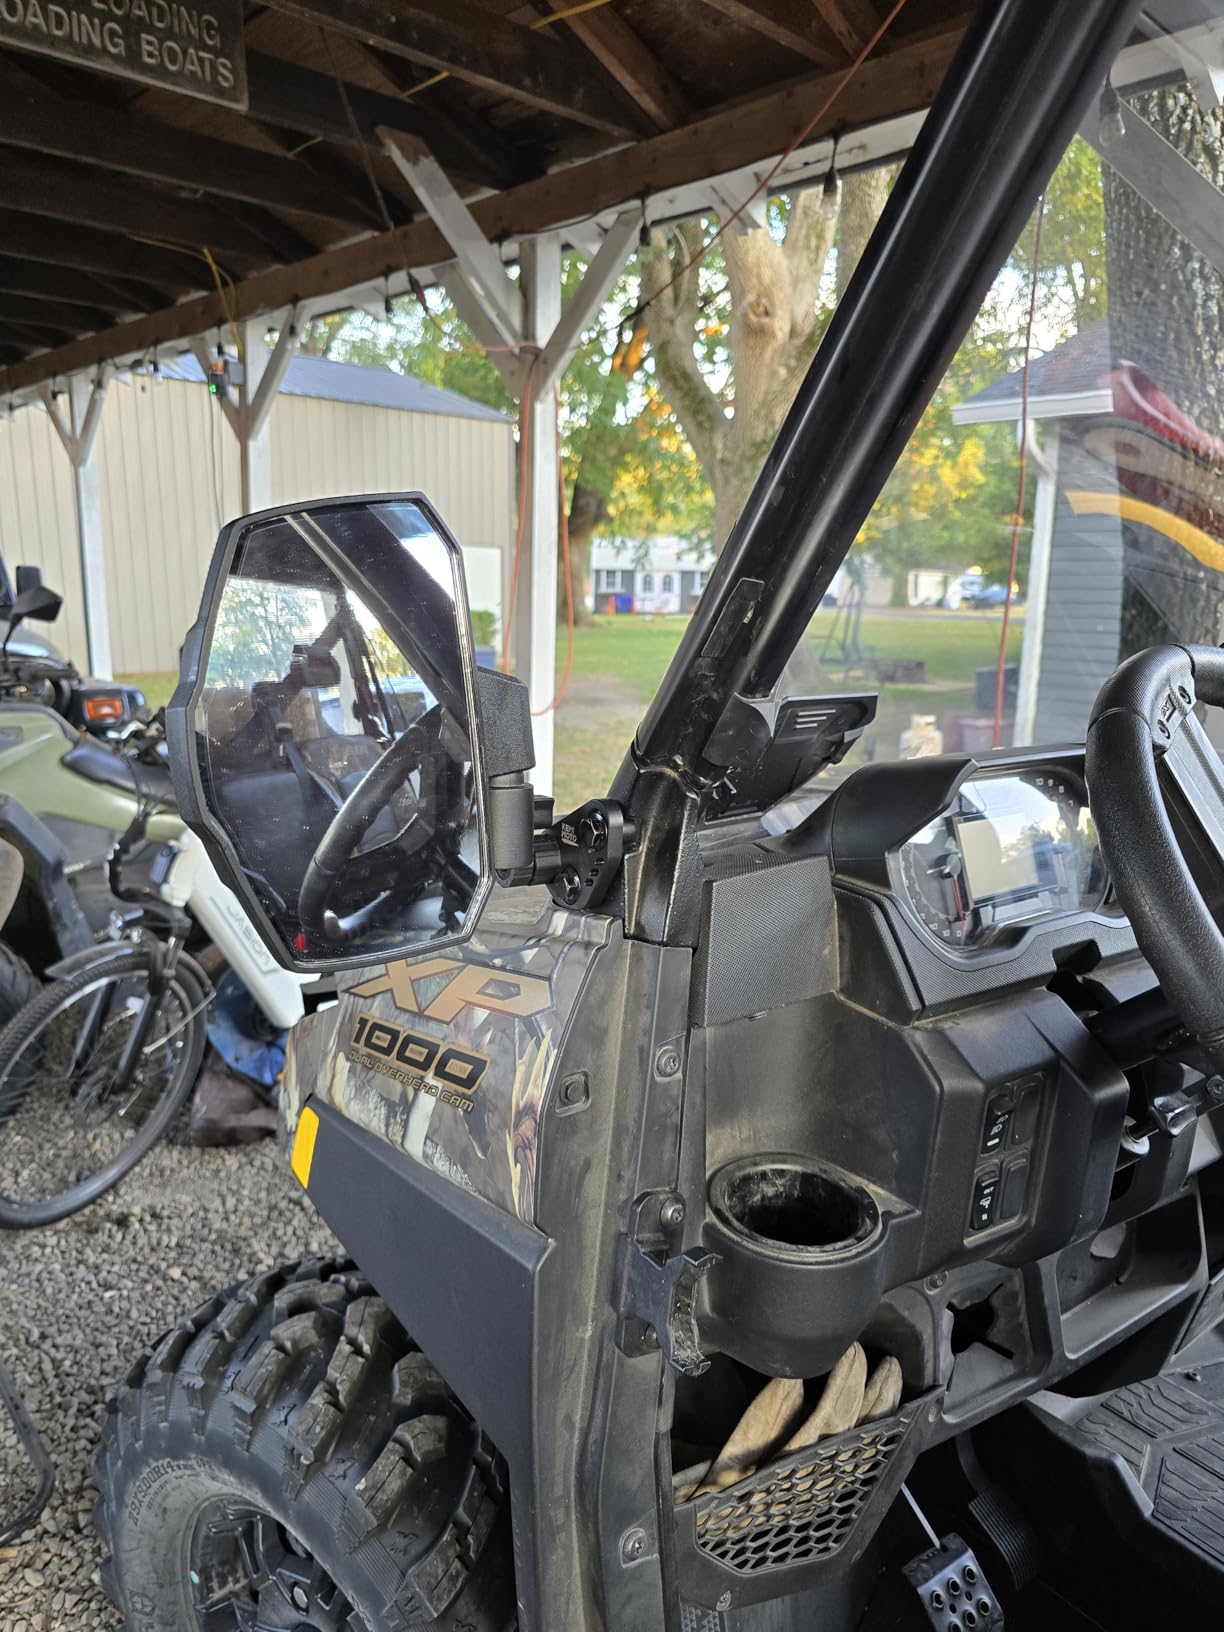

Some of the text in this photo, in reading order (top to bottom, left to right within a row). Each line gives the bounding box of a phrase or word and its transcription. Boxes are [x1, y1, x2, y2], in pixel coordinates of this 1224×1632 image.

[0, 0, 234, 89] OADING BOATS
[561, 831, 577, 842] MOTO
[341, 957, 556, 1025] XP
[349, 1051, 474, 1112] DUAL OVERHEAD CAM
[353, 1016, 489, 1091] 1000
